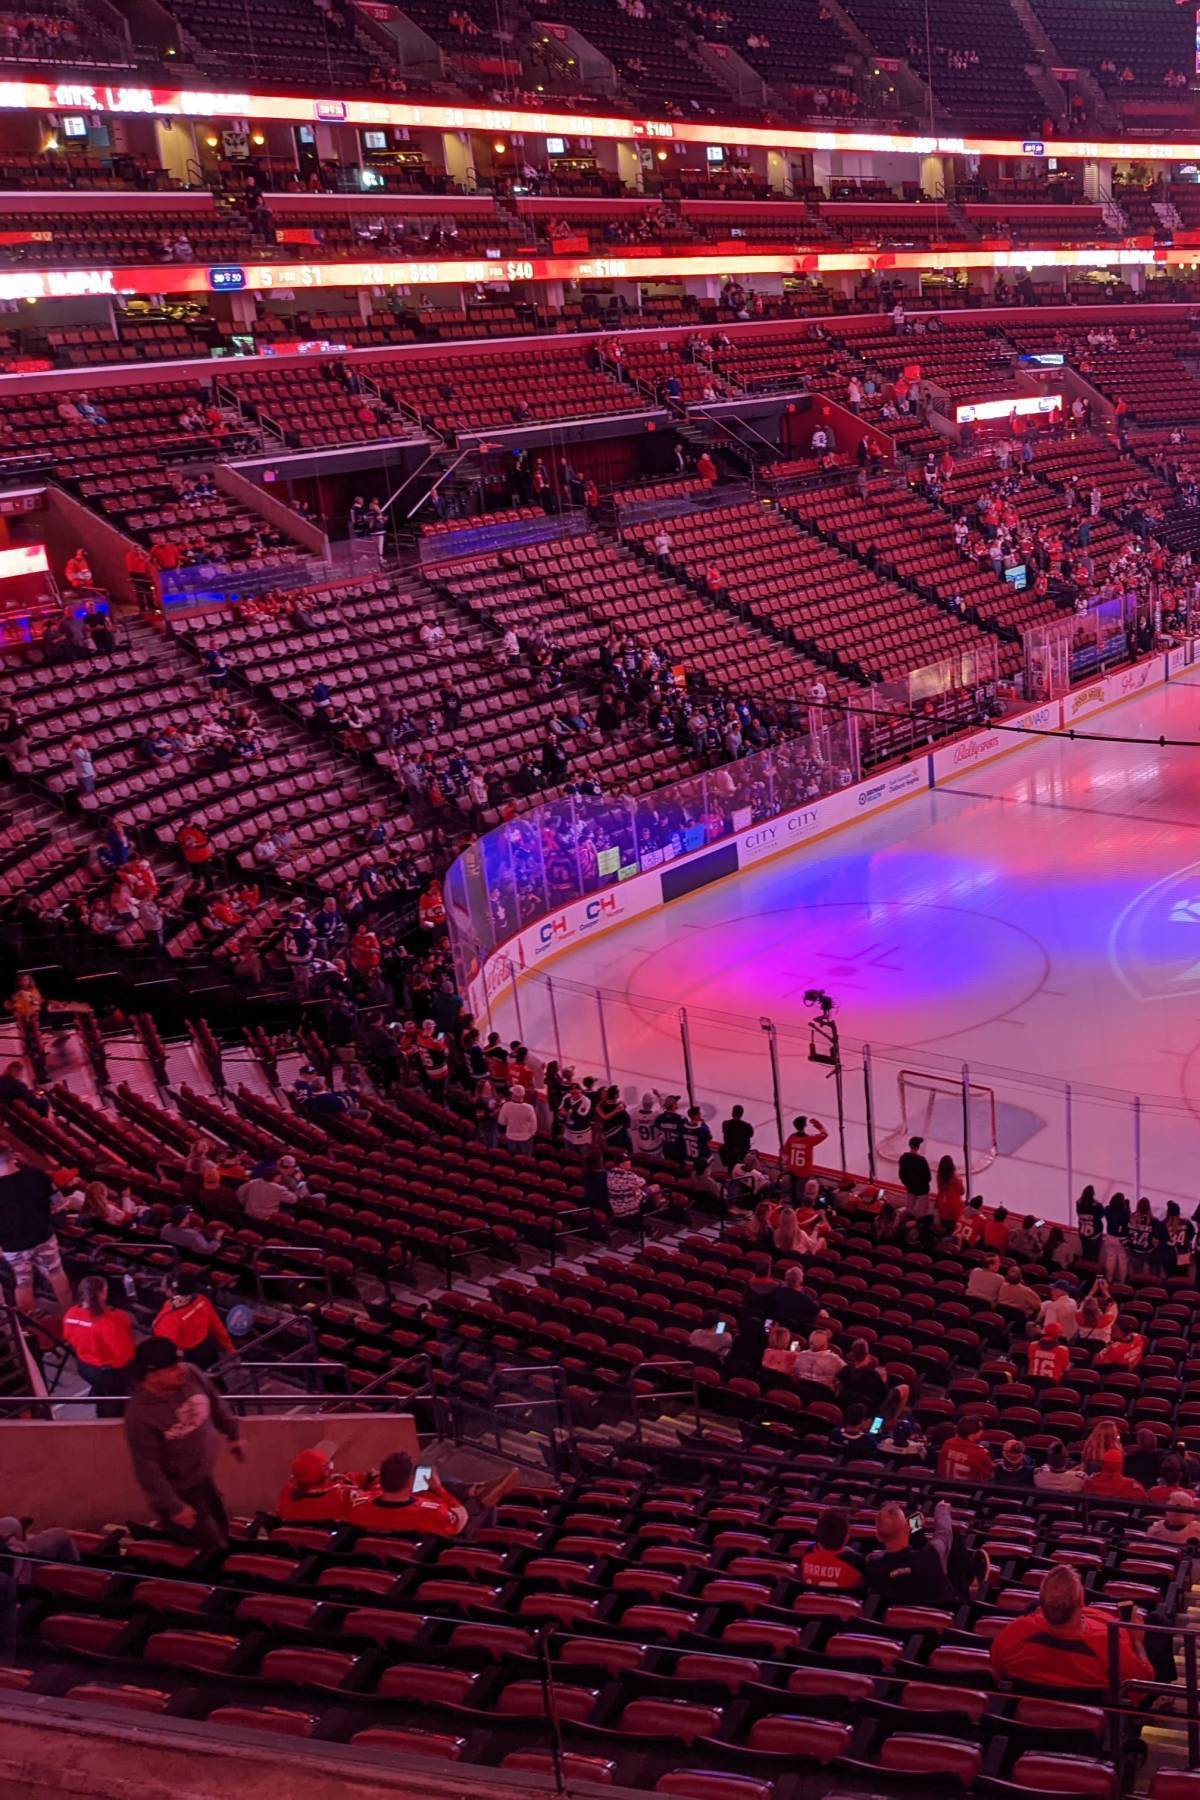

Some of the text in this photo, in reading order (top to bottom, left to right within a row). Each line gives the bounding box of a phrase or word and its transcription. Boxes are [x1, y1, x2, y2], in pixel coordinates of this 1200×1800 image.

[646, 122, 673, 137] $100
[507, 261, 533, 281] $40
[788, 809, 818, 831] CITY
[745, 826, 777, 848] CITY
[638, 1125, 656, 1141] 91
[791, 1148, 806, 1167] 16
